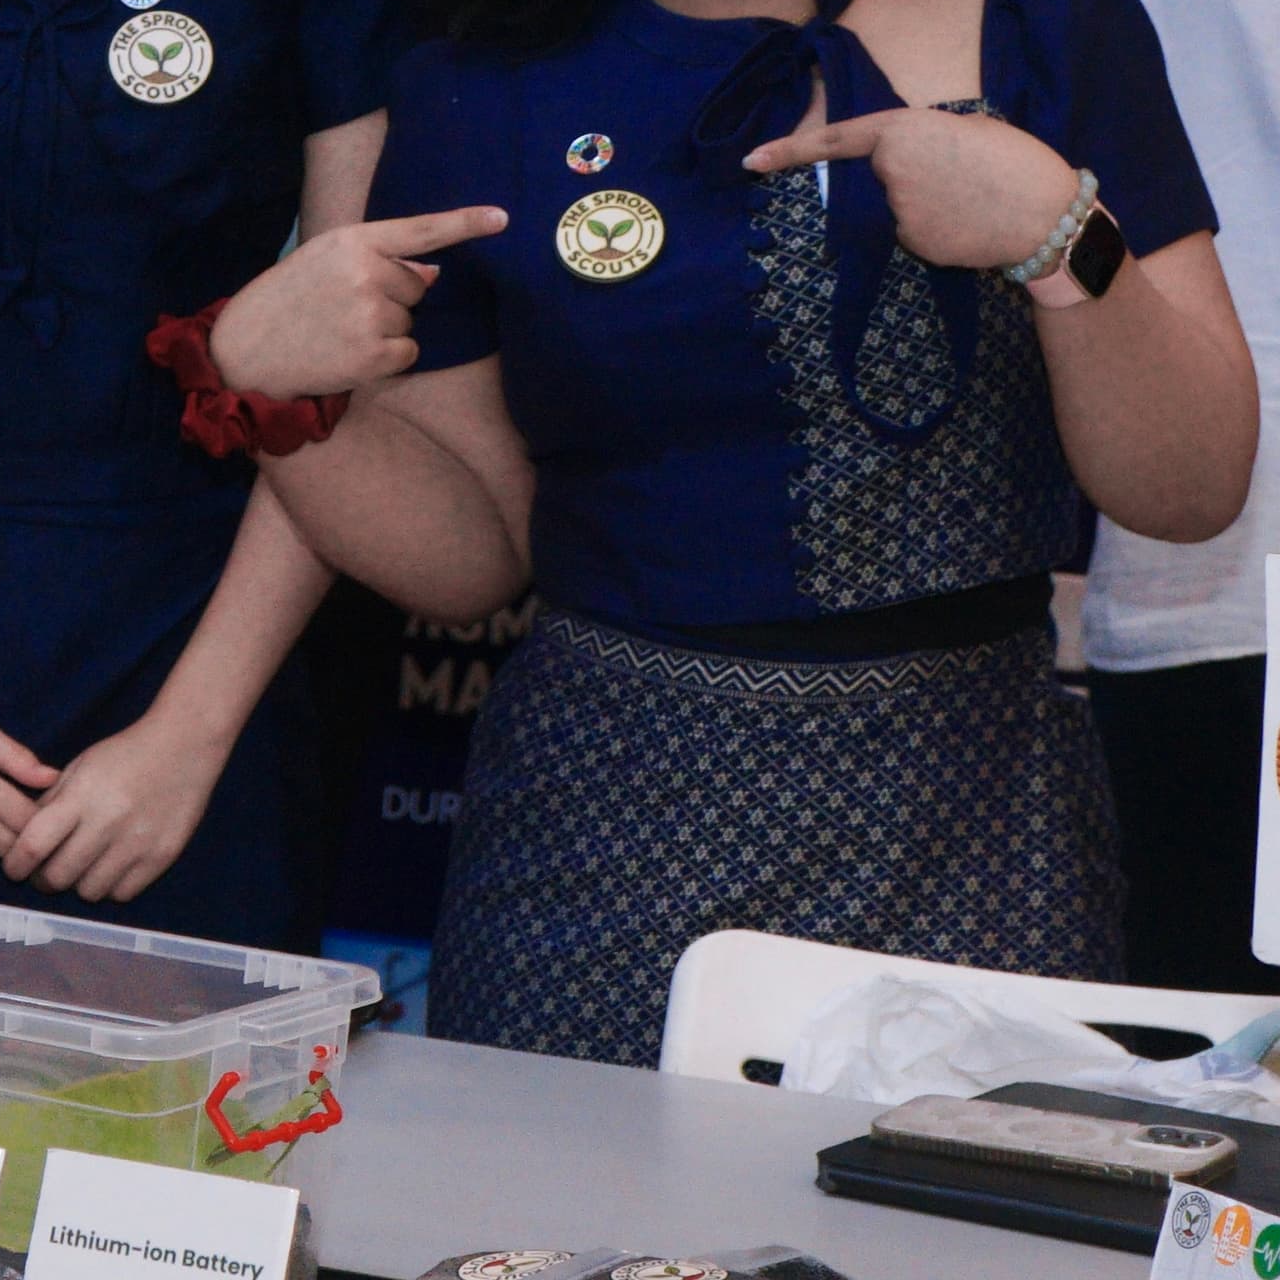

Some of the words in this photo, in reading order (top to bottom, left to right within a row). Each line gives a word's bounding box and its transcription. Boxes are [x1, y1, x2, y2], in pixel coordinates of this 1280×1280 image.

[113, 23, 140, 52] THE
[140, 13, 206, 45] SPROUT
[122, 72, 201, 99] SCOUTS
[560, 203, 590, 229] THE
[592, 192, 658, 222] SPROUT
[567, 249, 649, 275] SCOUTS
[49, 1224, 177, 1266] Lithium-ion
[182, 1249, 265, 1280] Battery
